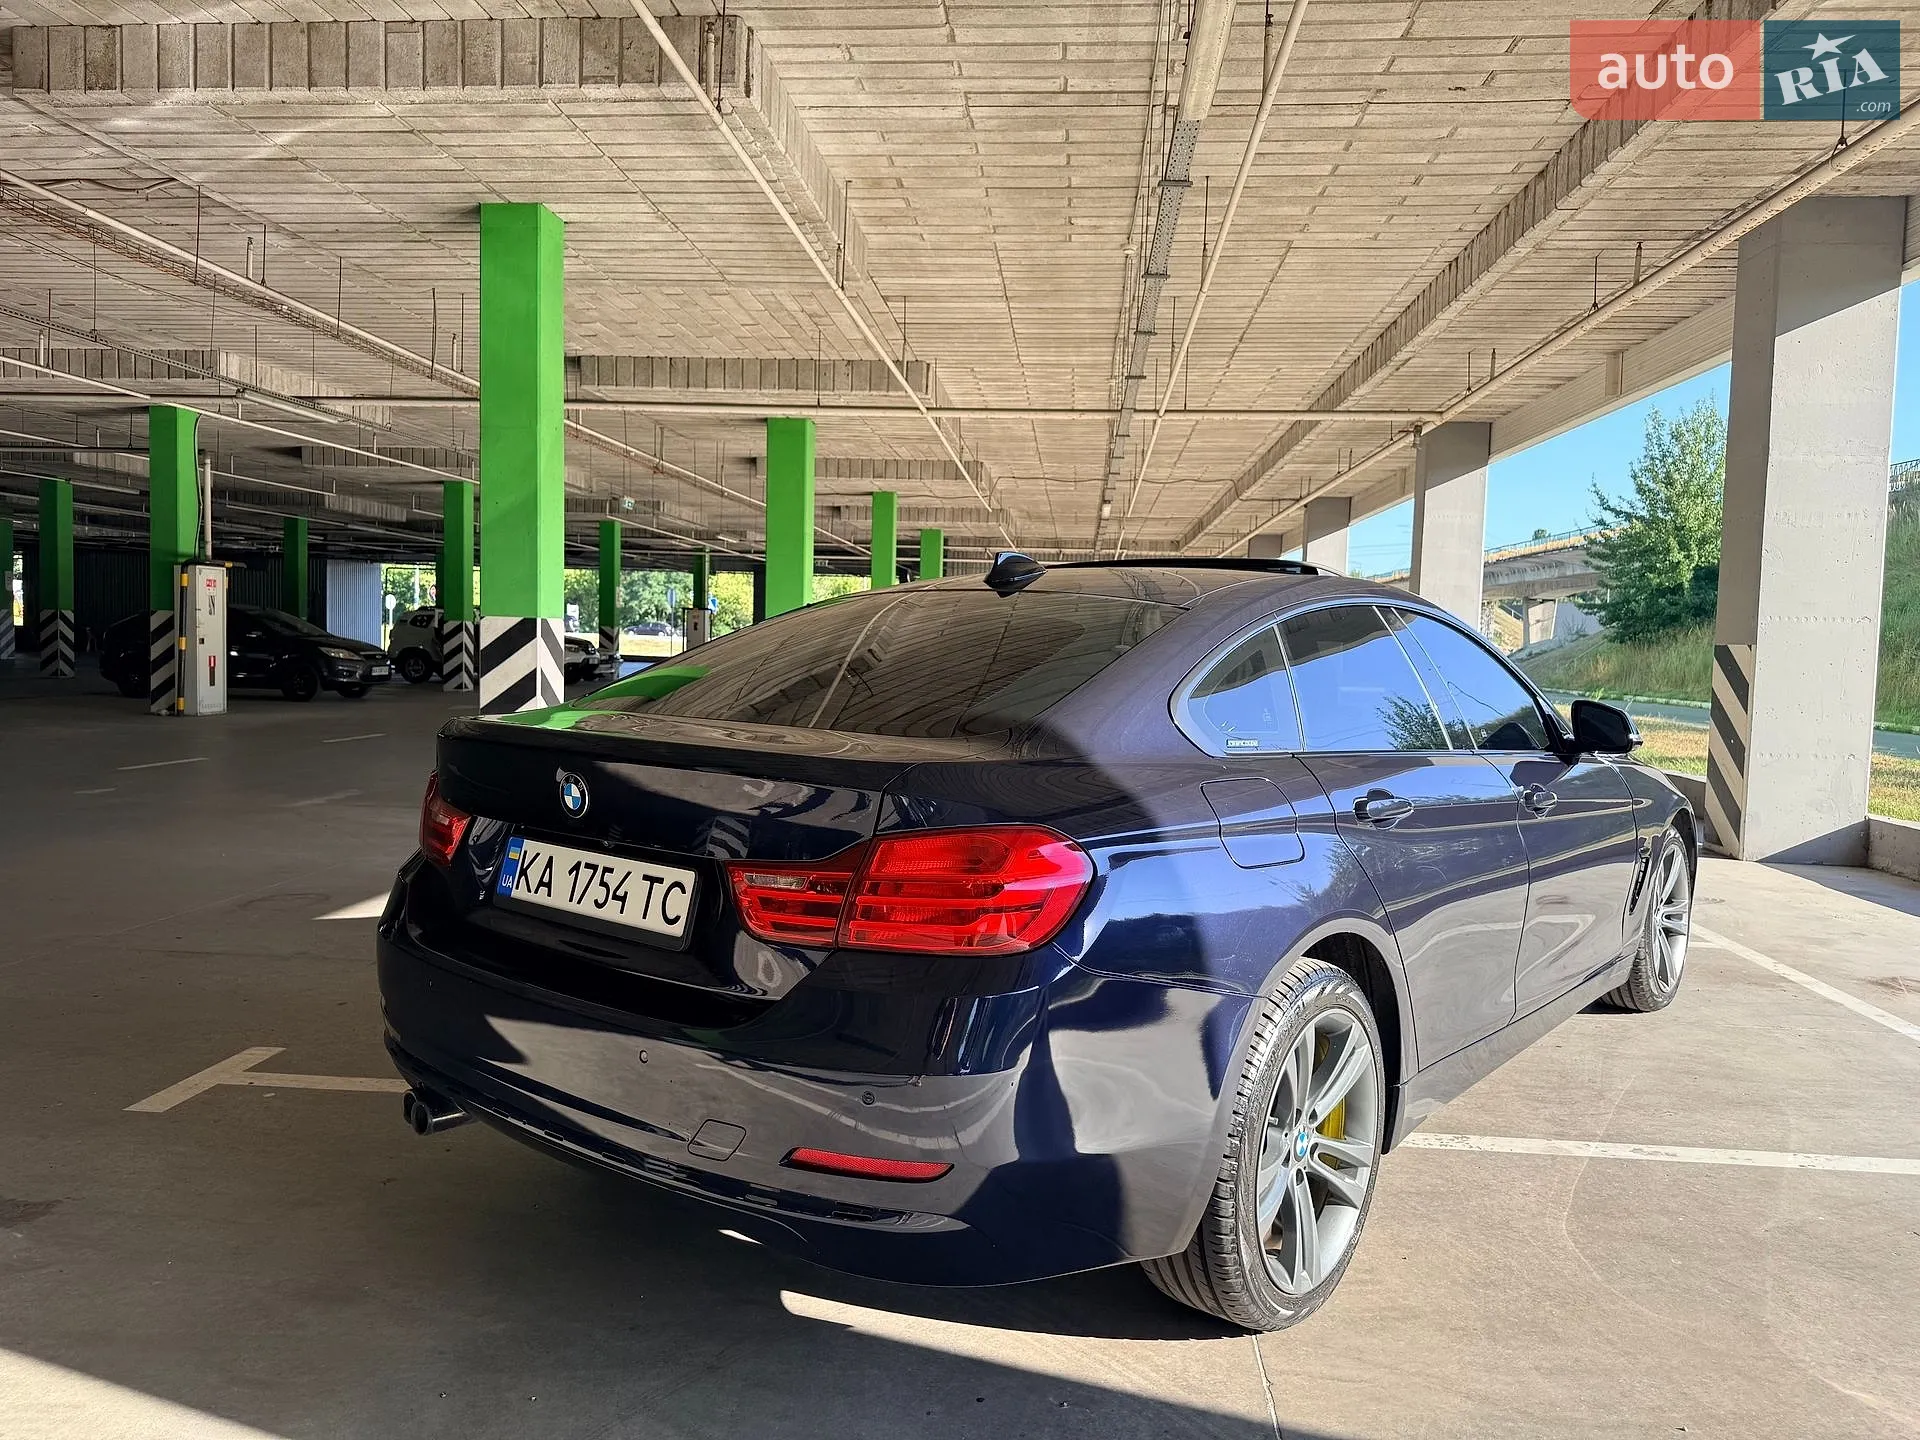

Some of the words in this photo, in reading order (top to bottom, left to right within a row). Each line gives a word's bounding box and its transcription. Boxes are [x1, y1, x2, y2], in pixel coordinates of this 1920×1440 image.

[502, 874, 513, 889] UA
[514, 849, 554, 898] KA
[567, 860, 632, 915] 1754
[641, 874, 686, 926] TC
